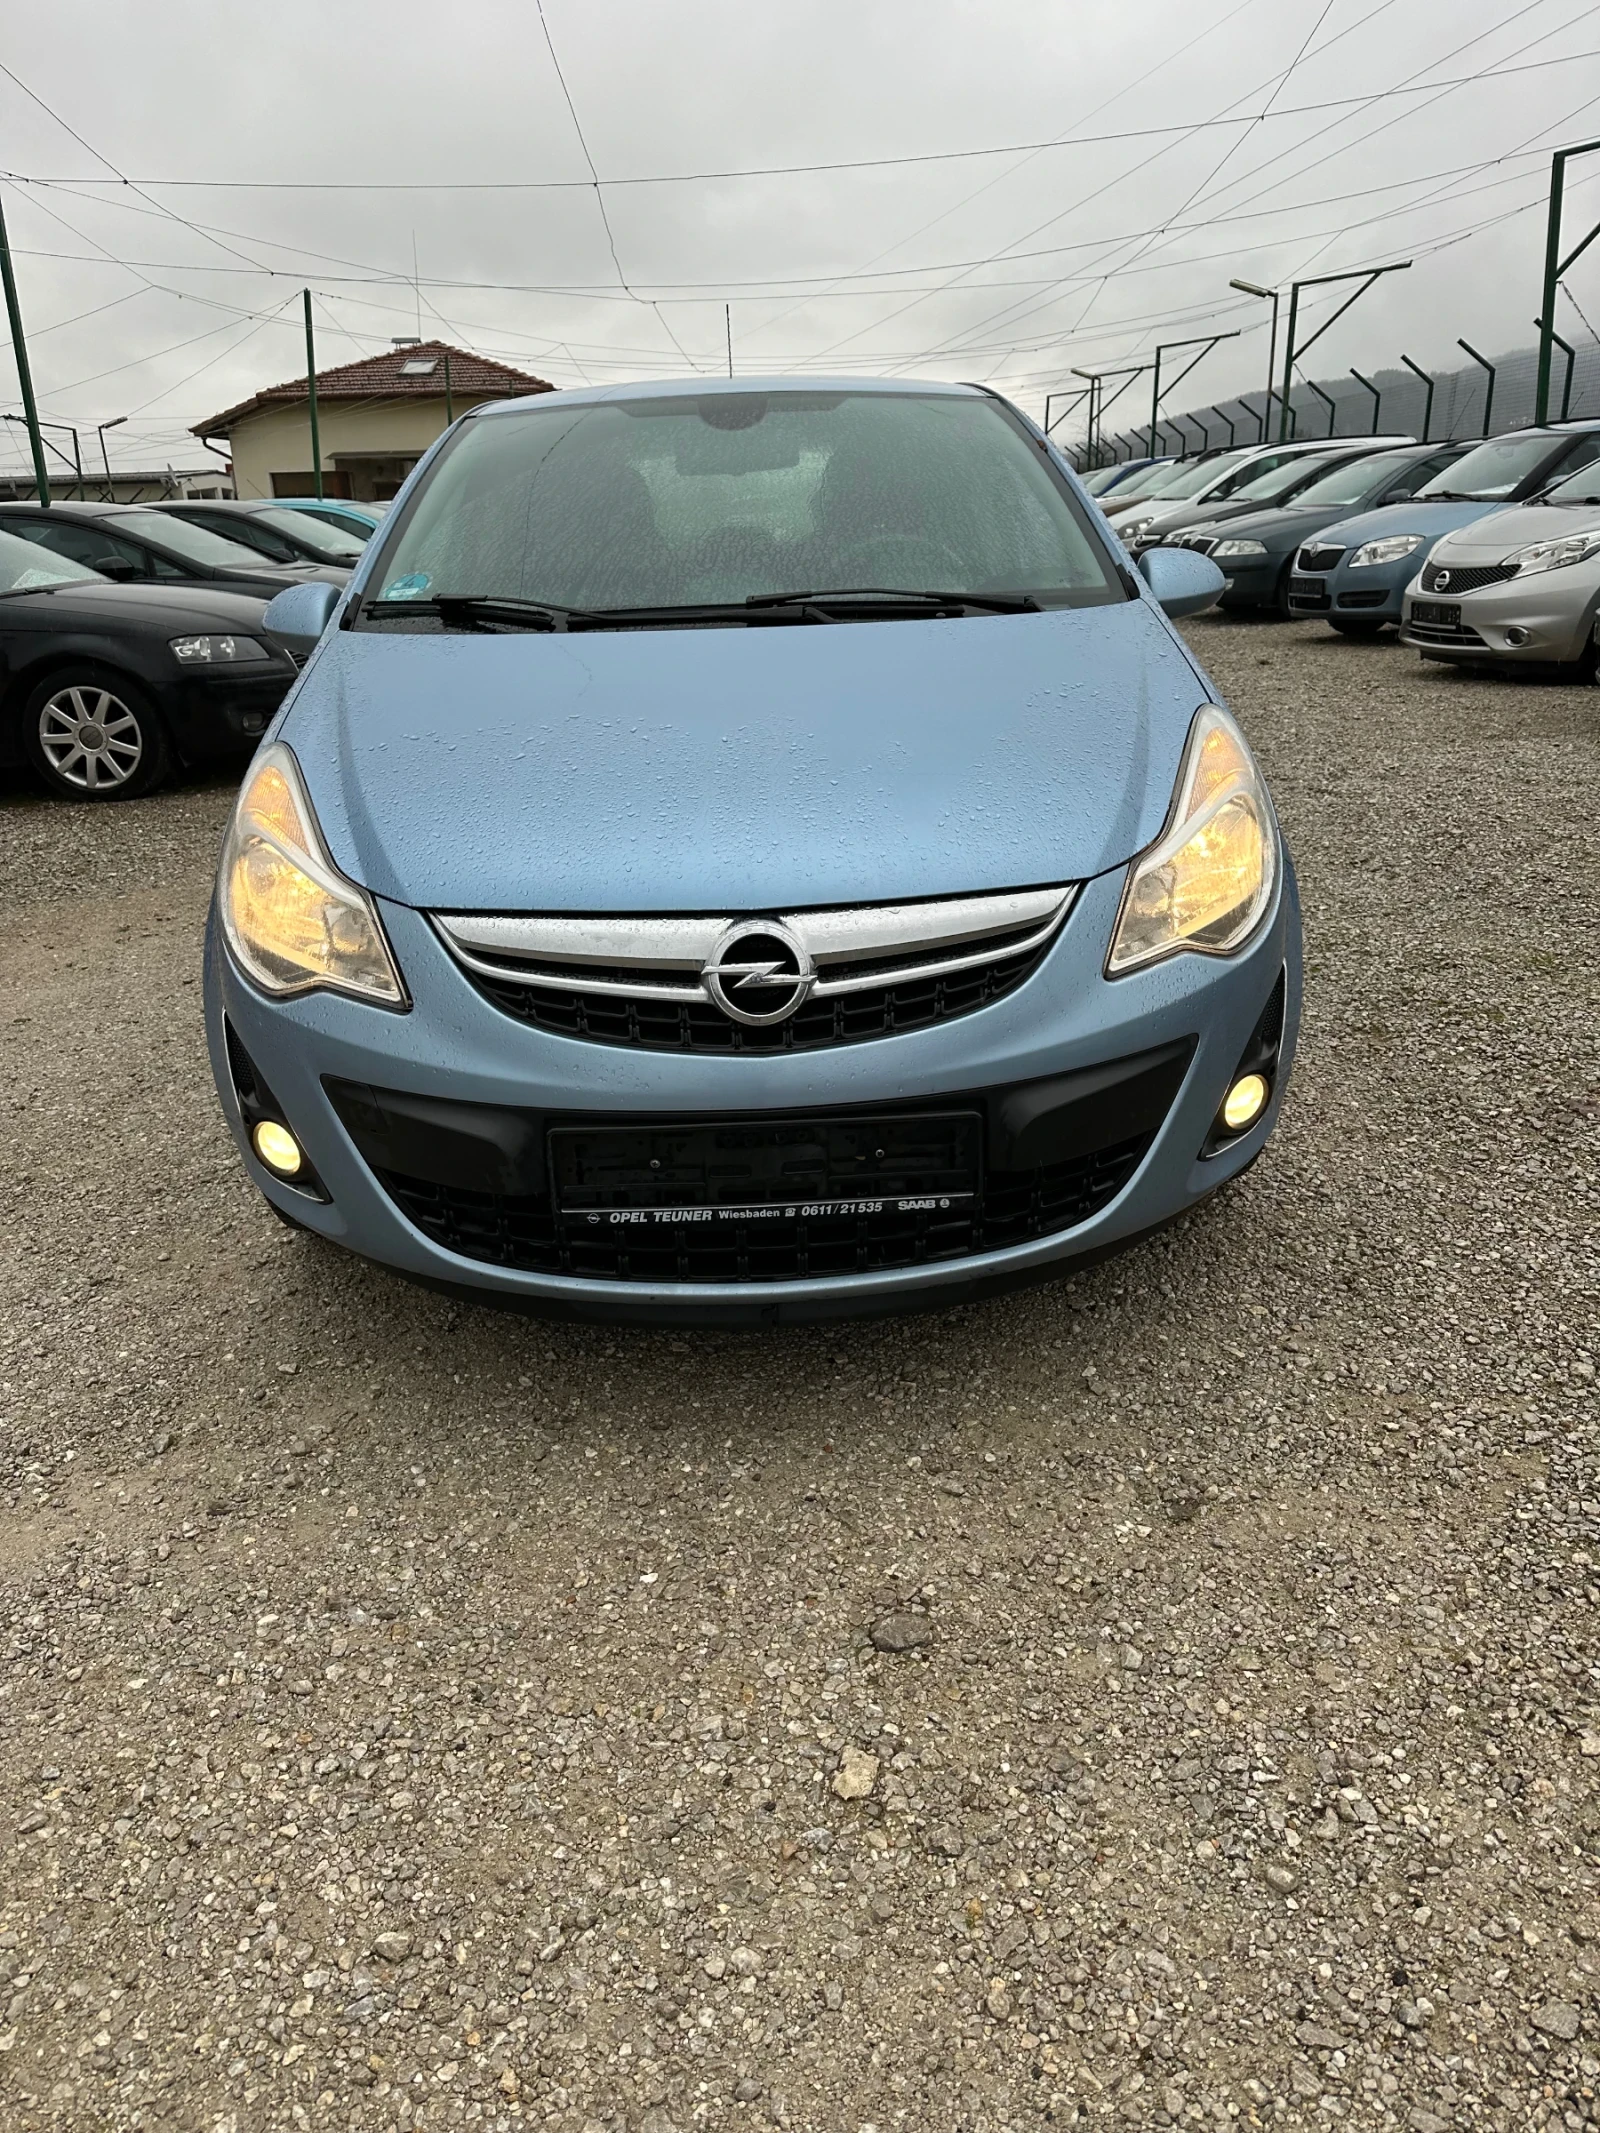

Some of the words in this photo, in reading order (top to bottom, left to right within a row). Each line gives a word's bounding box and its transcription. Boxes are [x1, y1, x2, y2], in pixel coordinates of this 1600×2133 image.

[404, 576, 416, 588] 4
[609, 1212, 648, 1224] OPEL
[653, 1210, 713, 1222] TEUNER
[718, 1209, 780, 1219] Wiesbaden
[897, 1199, 936, 1211] SAAB
